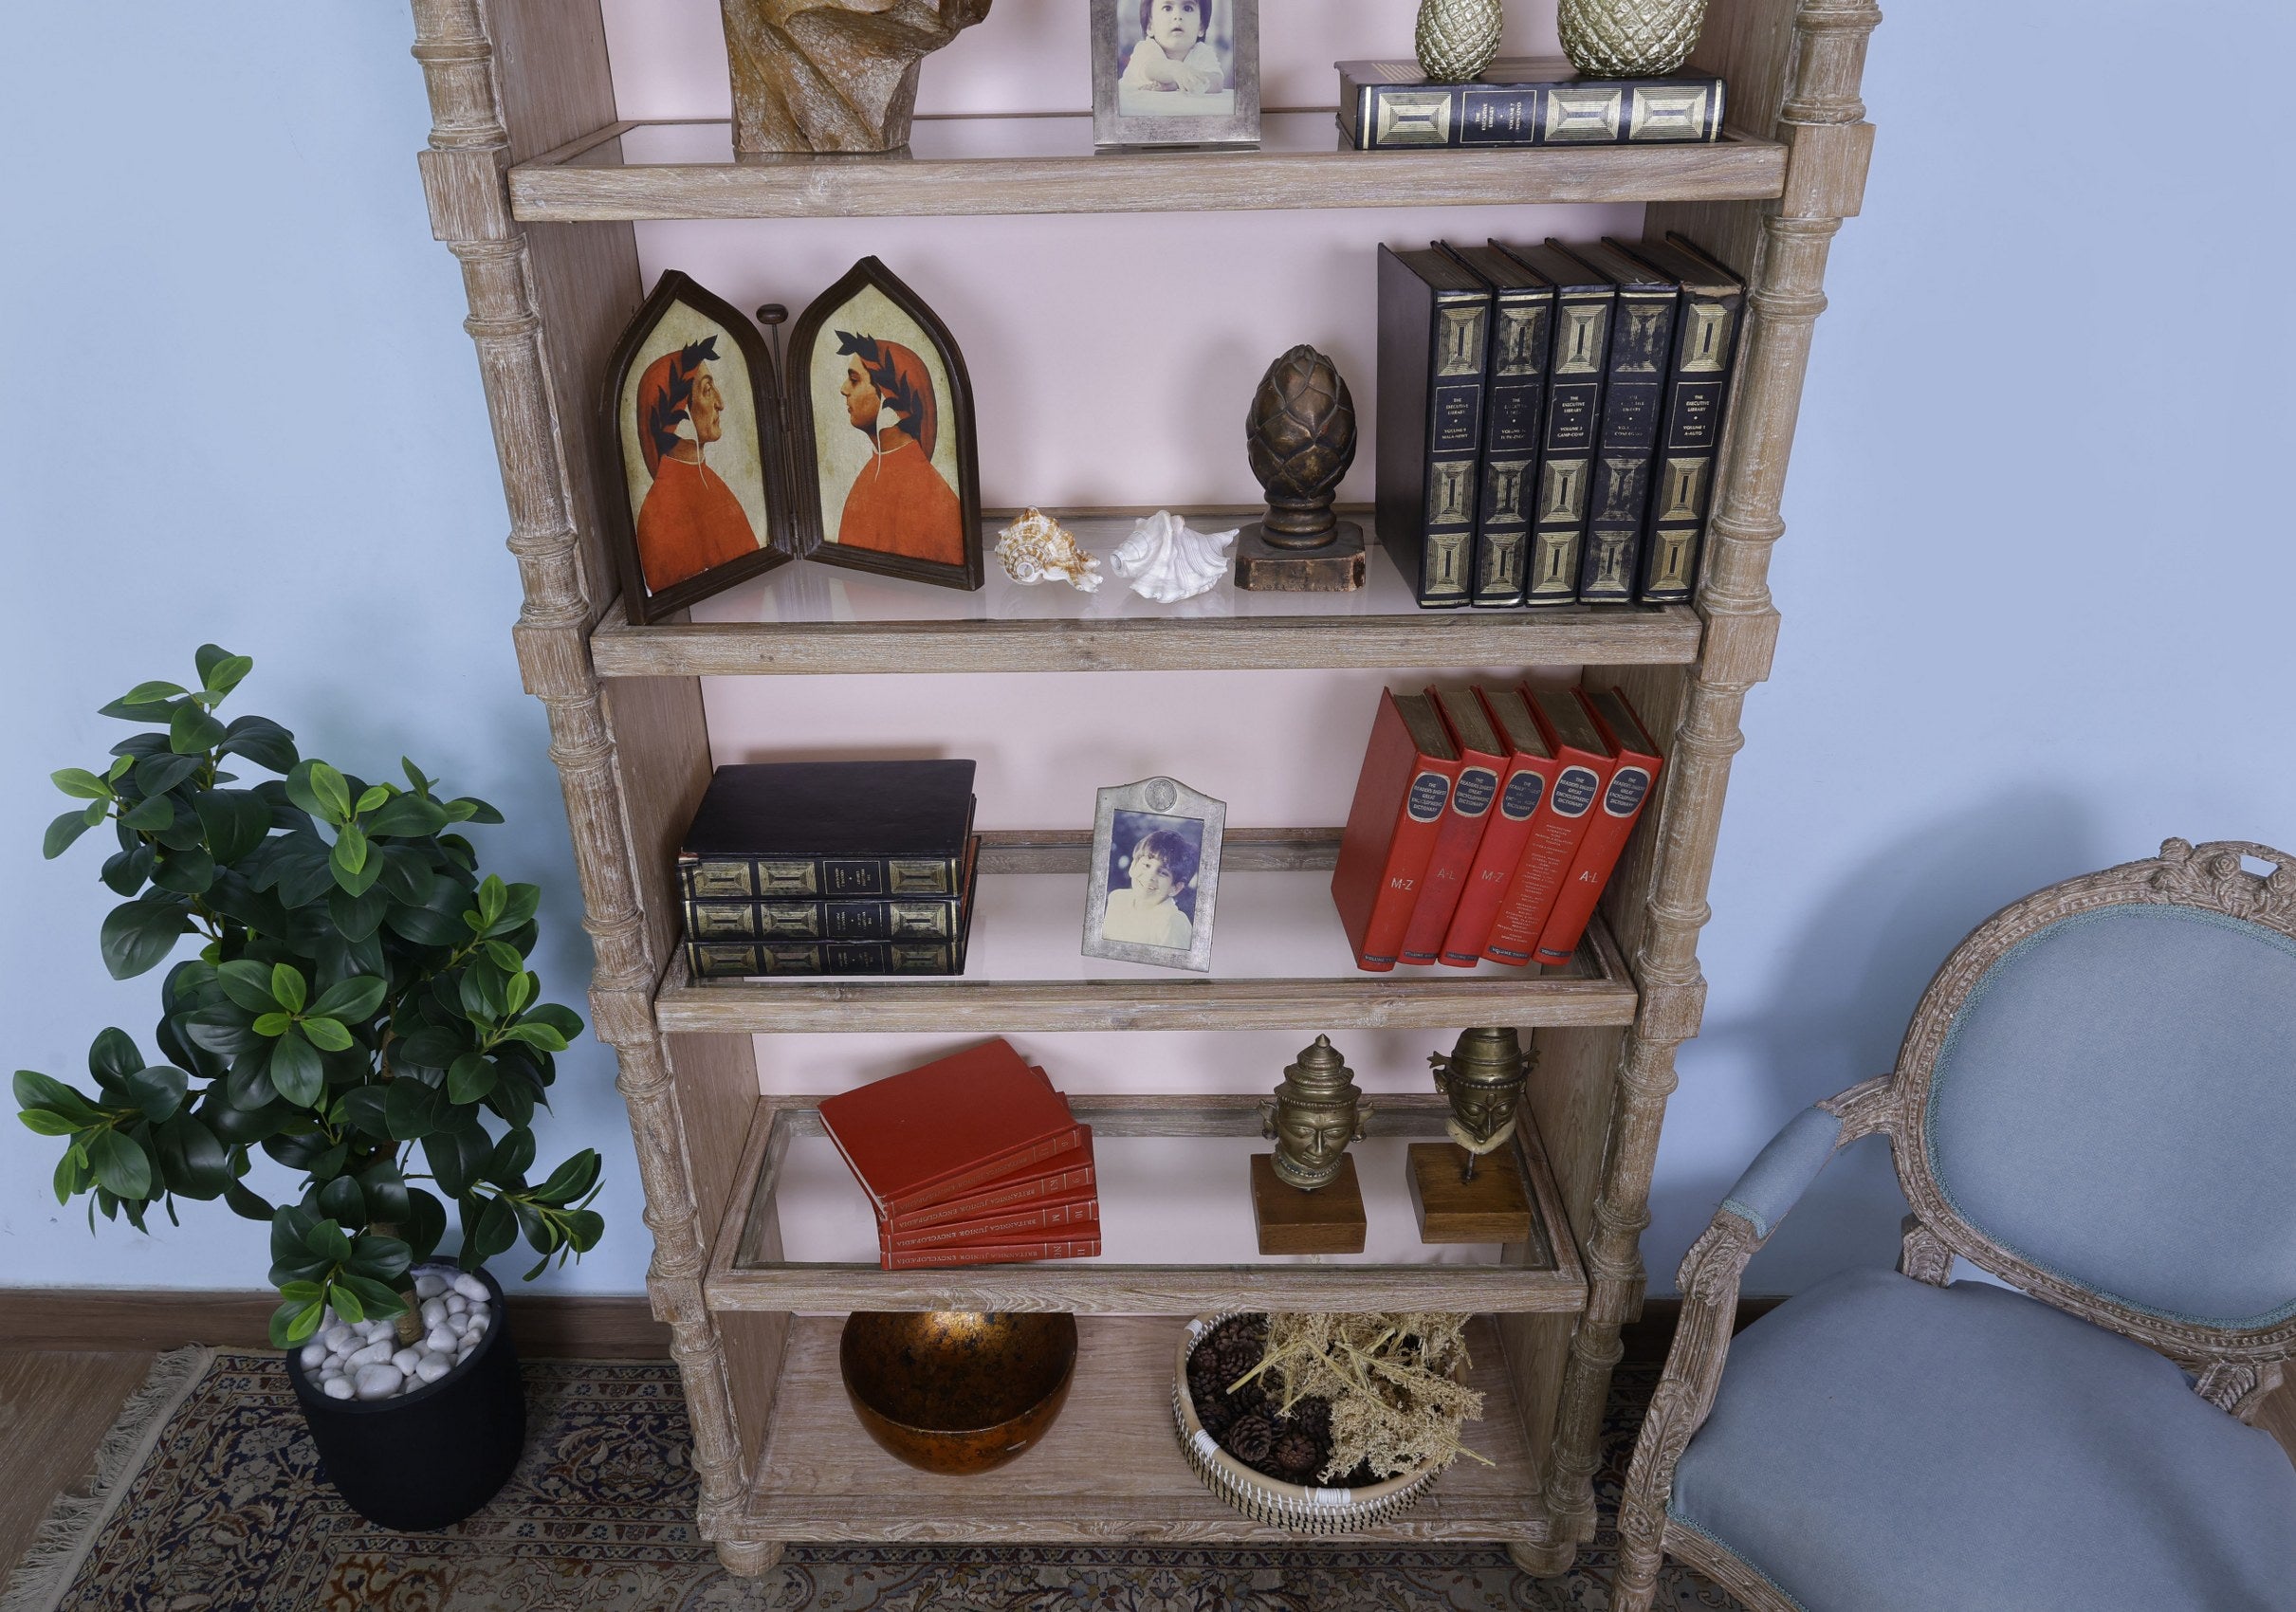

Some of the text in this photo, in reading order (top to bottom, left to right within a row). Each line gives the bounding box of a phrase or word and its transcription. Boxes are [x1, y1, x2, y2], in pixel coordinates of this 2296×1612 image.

[1437, 868, 1456, 881] A-L
[1482, 870, 1504, 883] M-Z
[1579, 870, 1598, 884] A-L
[1390, 877, 1414, 890] M-Z
[990, 1189, 1035, 1204] BRITANNICA
[959, 1200, 988, 1212] JUNIOR
[1052, 1214, 1060, 1222] M
[1075, 1210, 1083, 1218] 10
[989, 1218, 1037, 1230] BRITANNICA
[959, 1225, 987, 1236] JUNIOR
[960, 1252, 989, 1260] JUNIOR
[989, 1251, 1038, 1259] BRITANNICA
